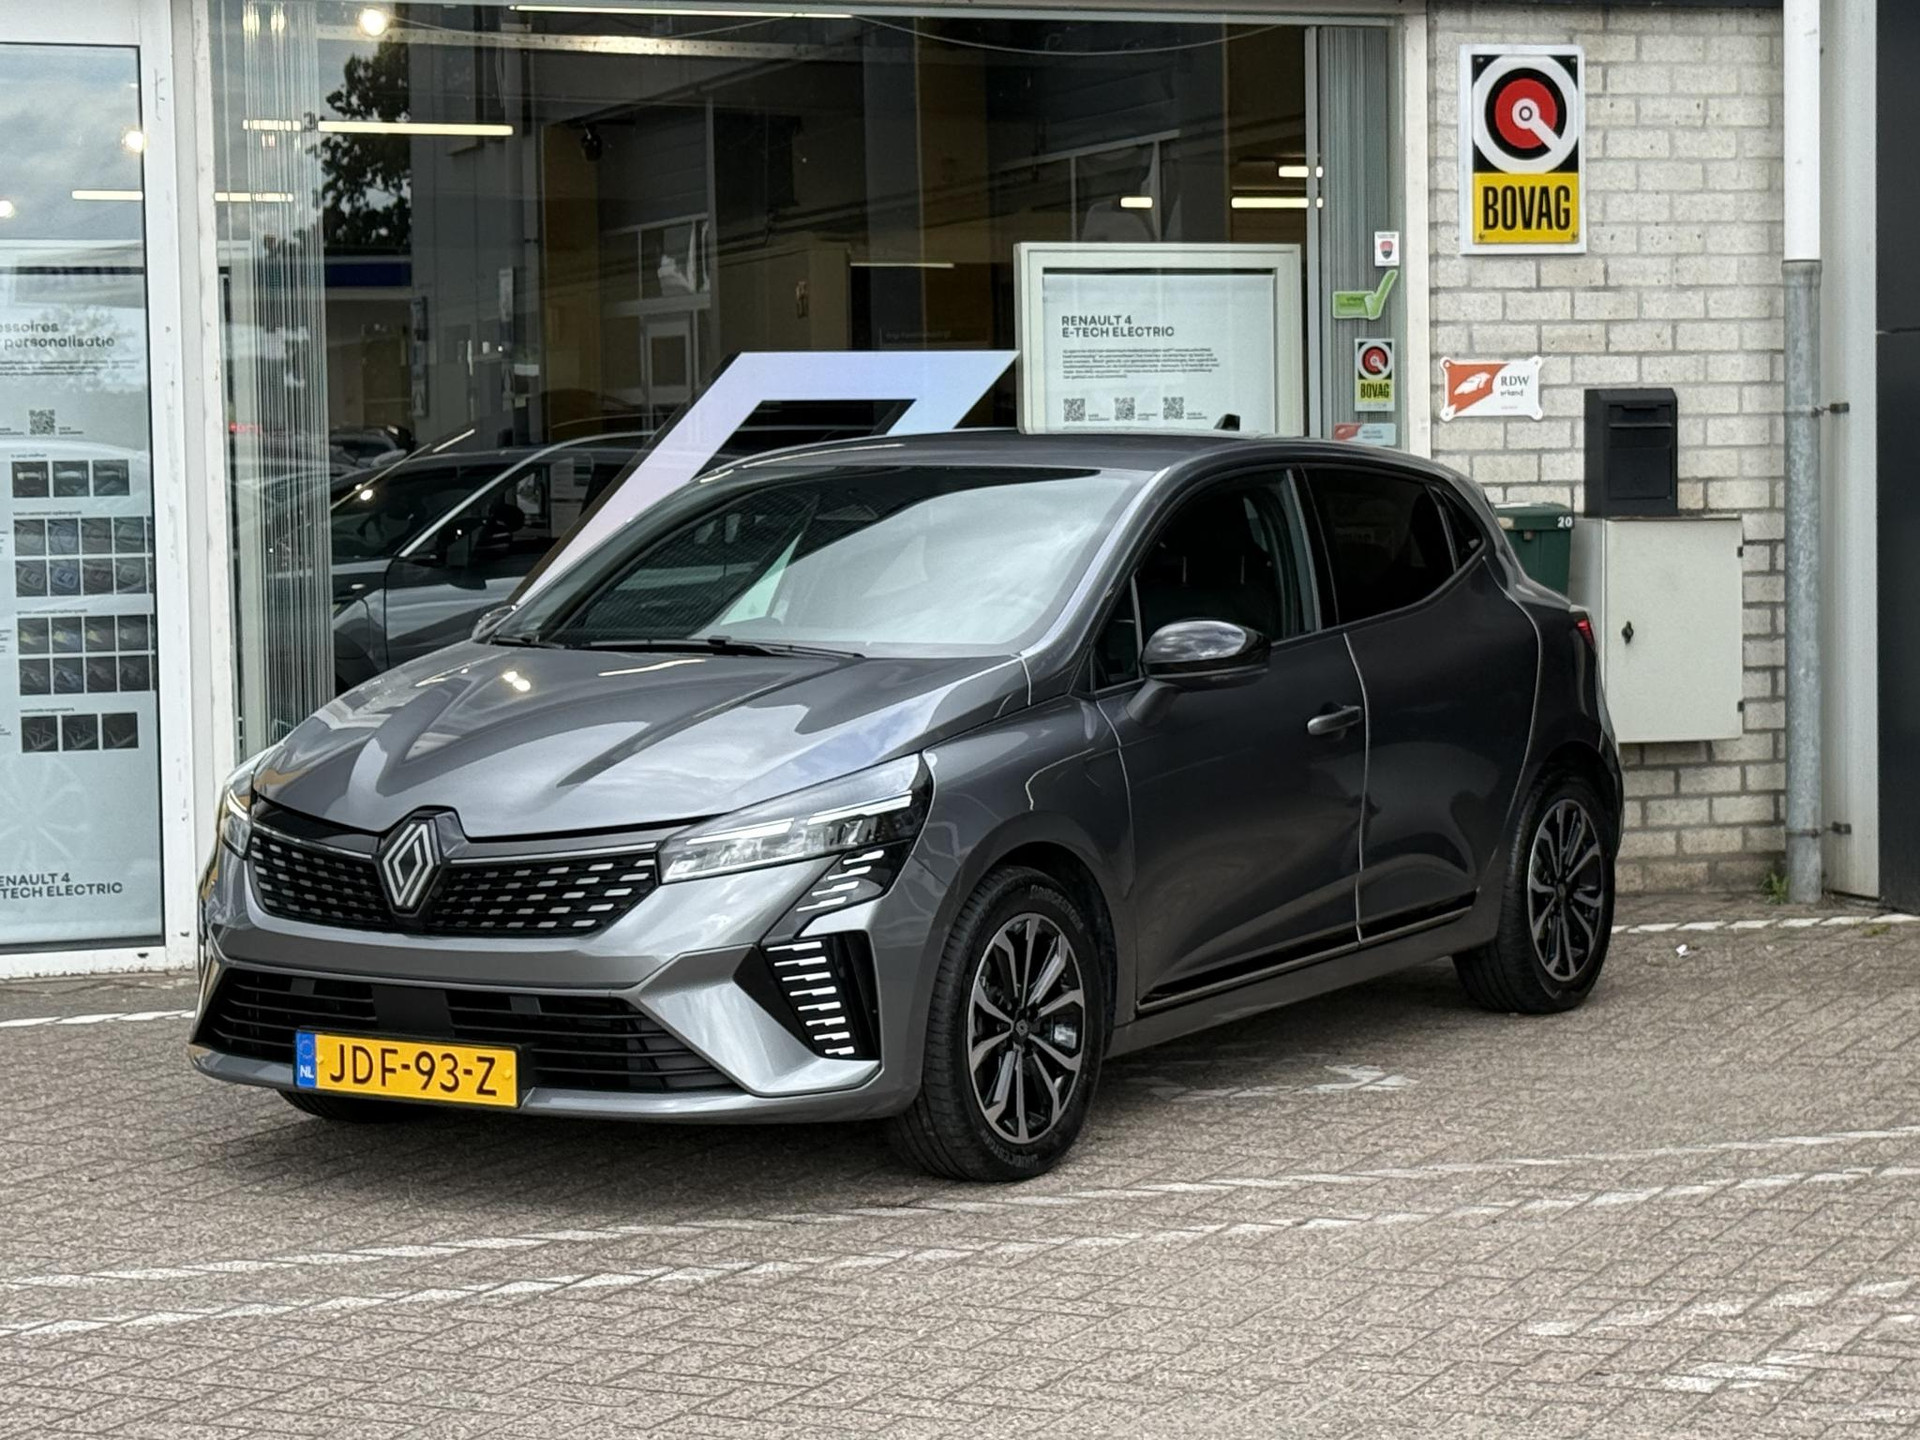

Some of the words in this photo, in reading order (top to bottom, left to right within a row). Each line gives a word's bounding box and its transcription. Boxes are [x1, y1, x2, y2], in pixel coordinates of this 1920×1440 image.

[1483, 185, 1570, 231] BOVAG
[1061, 315, 1122, 326] RENAULT
[1124, 314, 1132, 325] 4
[1062, 326, 1109, 338] E-TECH
[1112, 326, 1175, 338] ELECTRIC
[1500, 375, 1530, 387] RDW
[1360, 383, 1390, 399] BOVAG
[1557, 516, 1573, 528] 20
[60, 872, 71, 883] 4
[47, 882, 123, 897] ELECTRIC
[300, 1065, 315, 1078] NL
[330, 1044, 497, 1097] JDF-93-Z
